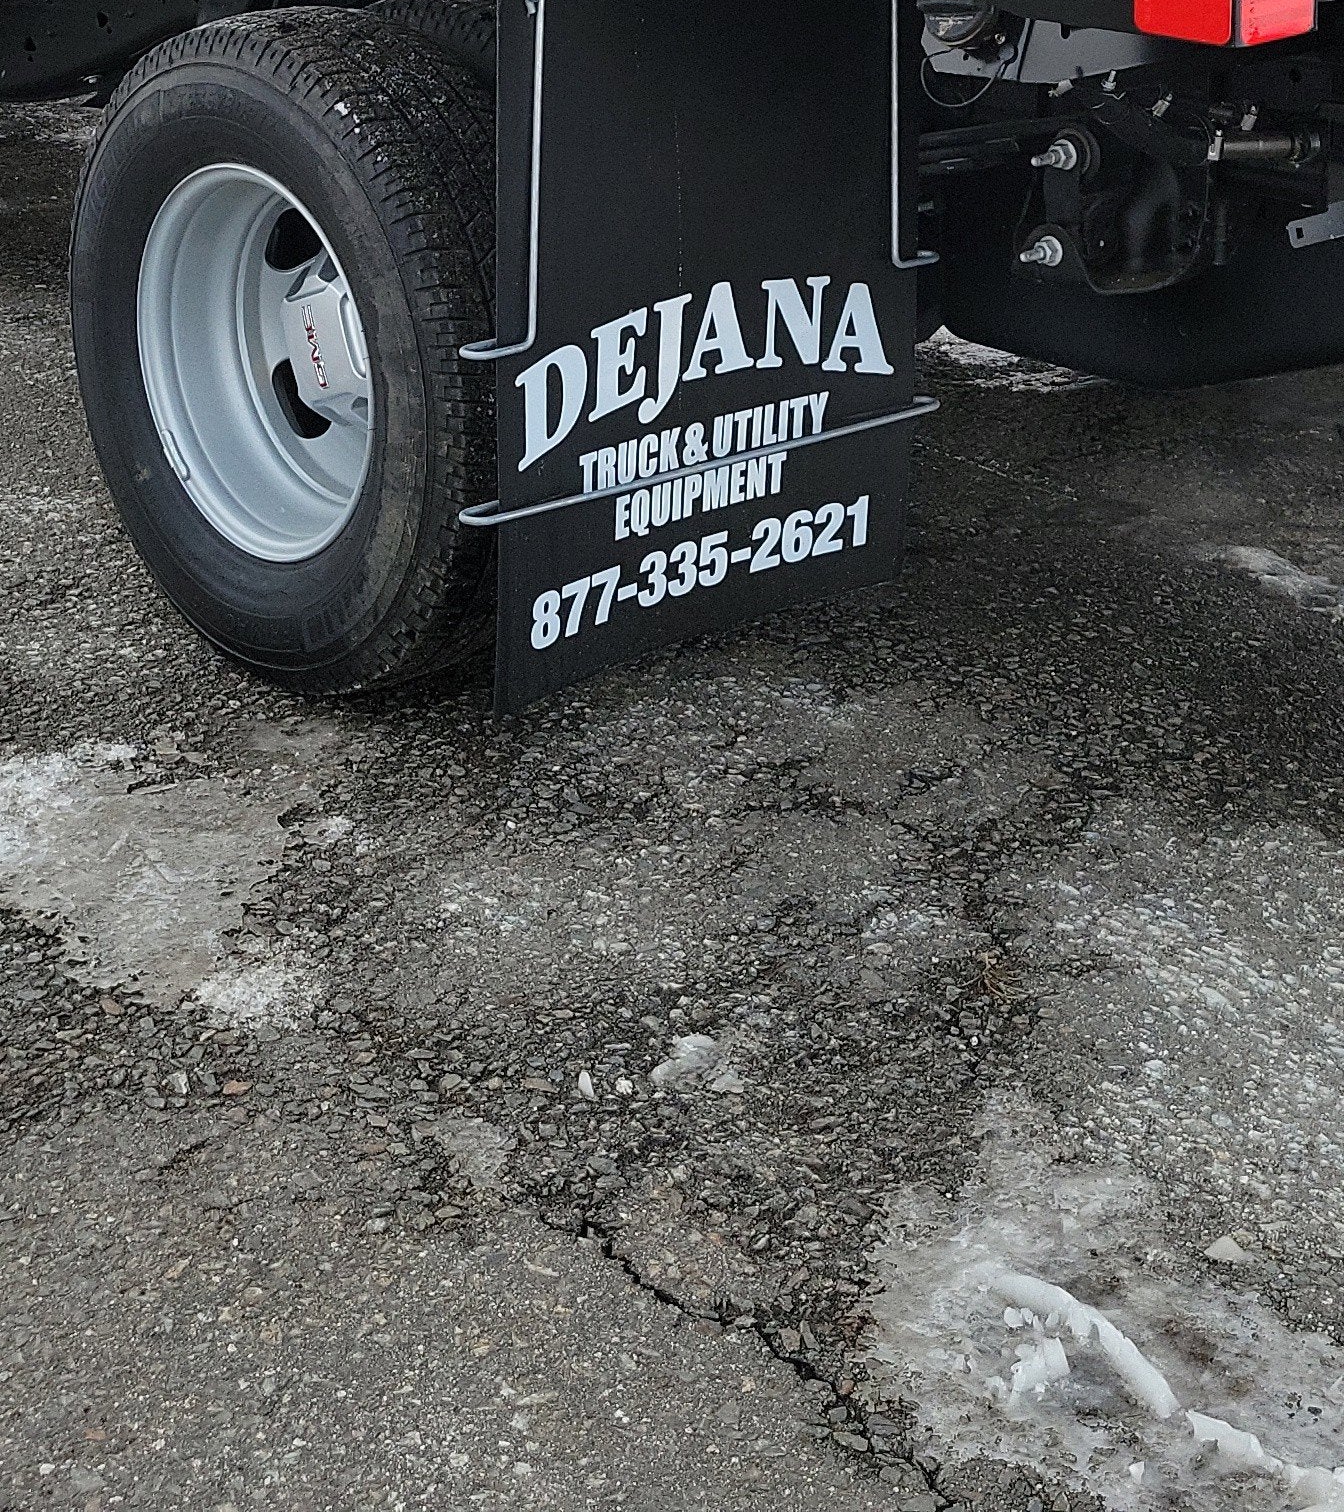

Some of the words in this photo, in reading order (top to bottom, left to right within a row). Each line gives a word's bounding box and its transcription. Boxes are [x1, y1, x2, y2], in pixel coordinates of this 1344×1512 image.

[301, 304, 330, 390] GMC
[514, 275, 895, 473] DEJANA
[579, 427, 681, 495] TRUCK
[712, 391, 830, 457] UTILITY
[614, 451, 787, 541] EQUIPMENT
[529, 494, 870, 651] 877-335-2621
